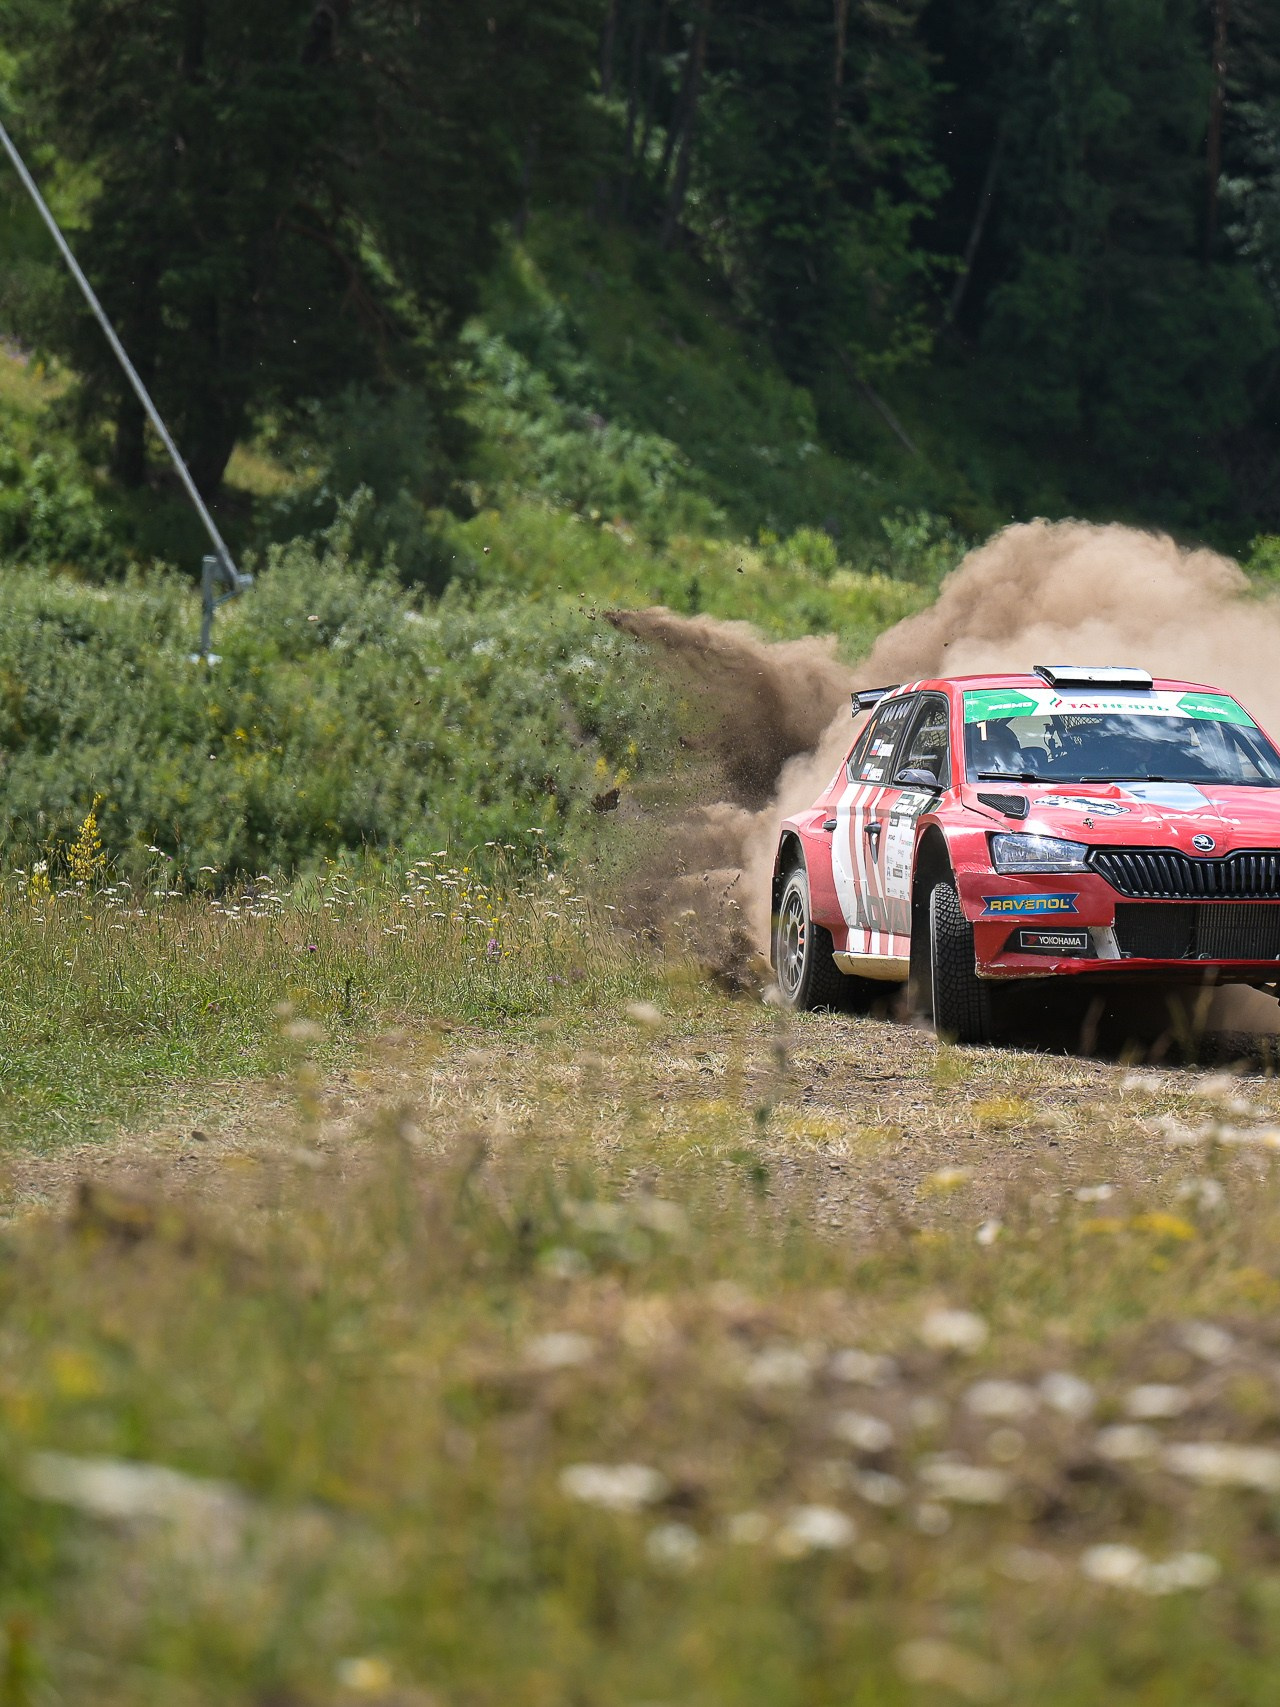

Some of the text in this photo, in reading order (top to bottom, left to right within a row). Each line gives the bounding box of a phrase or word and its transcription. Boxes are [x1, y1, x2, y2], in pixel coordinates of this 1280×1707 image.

[976, 721, 987, 741] 1
[1141, 813, 1241, 825] ADVAN
[989, 898, 1070, 911] RAVENOL
[1038, 935, 1082, 946] YOKOHAMA
